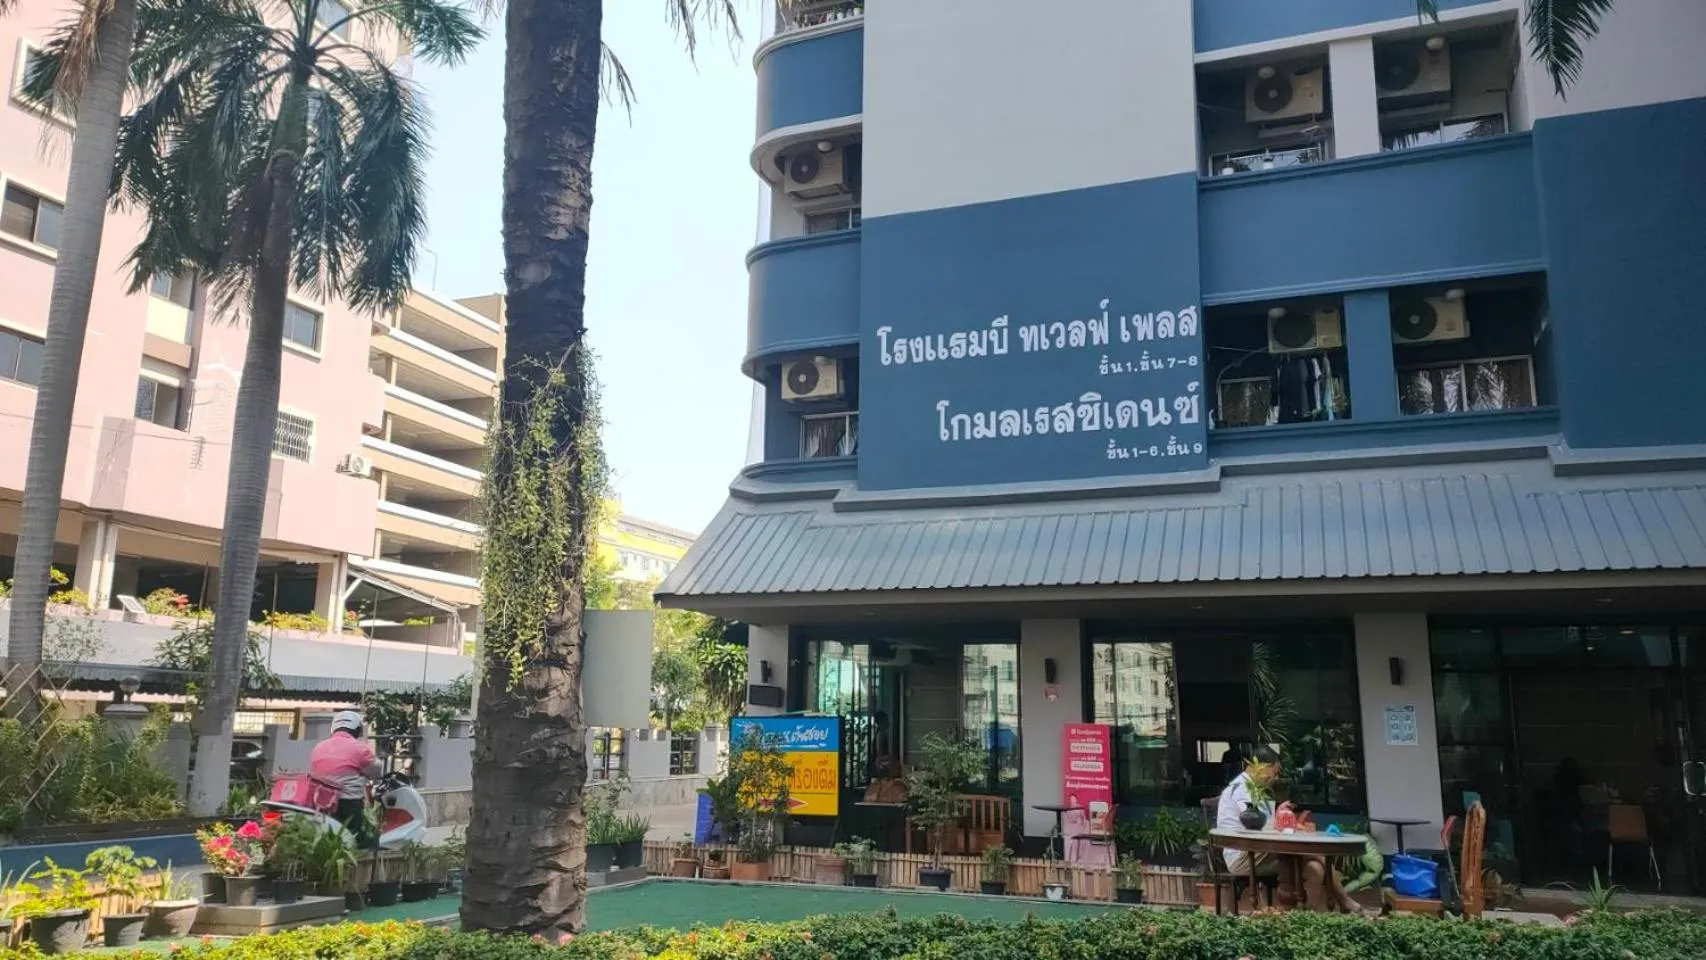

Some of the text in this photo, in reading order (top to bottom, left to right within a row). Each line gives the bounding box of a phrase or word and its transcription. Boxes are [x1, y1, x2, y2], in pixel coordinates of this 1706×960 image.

[876, 298, 1198, 366] โรงแรมบี ทเวลฟ์ เพลส
